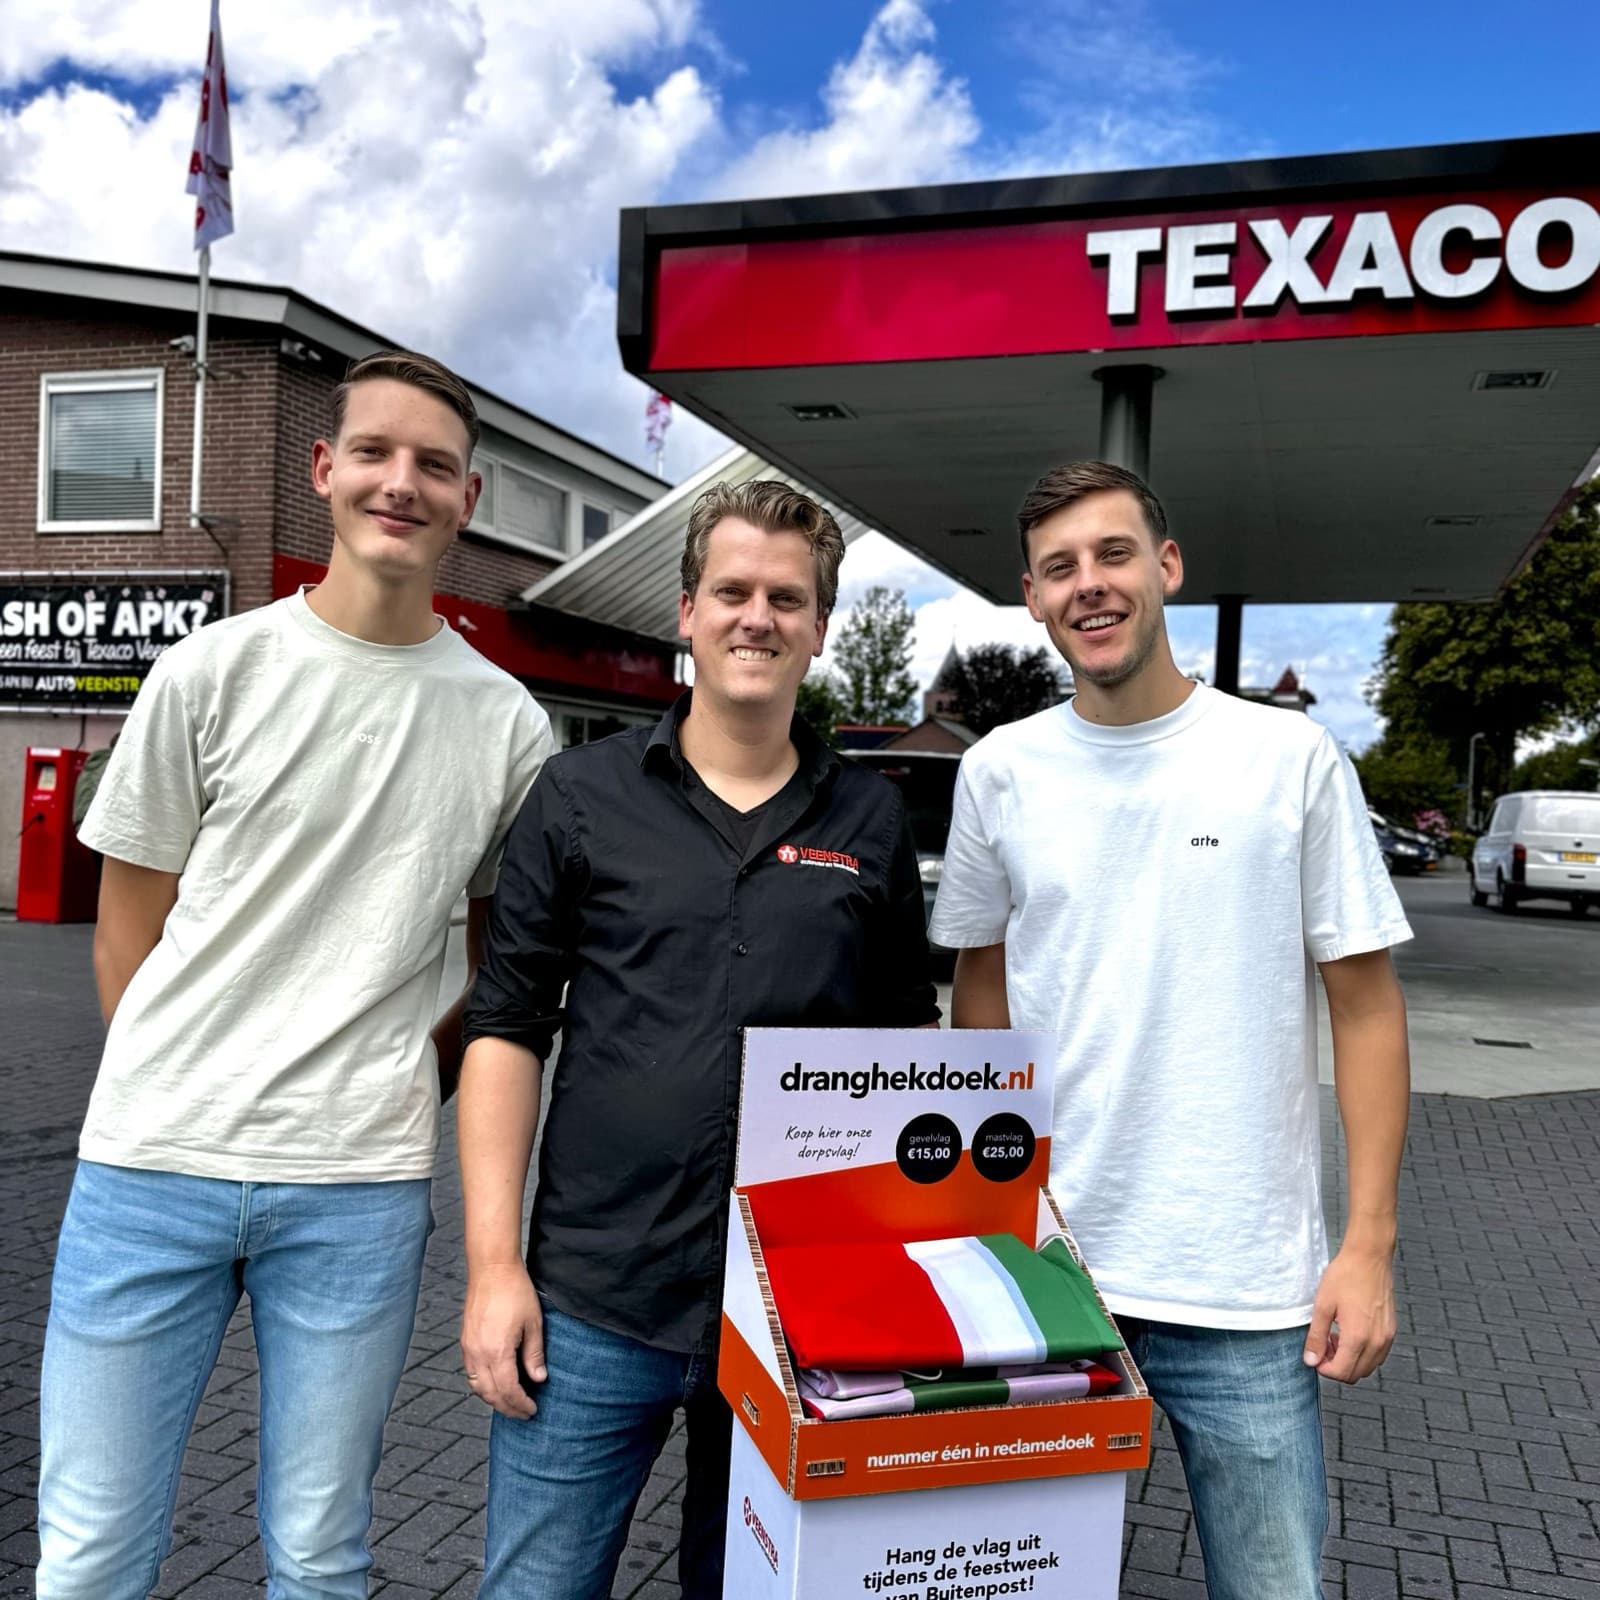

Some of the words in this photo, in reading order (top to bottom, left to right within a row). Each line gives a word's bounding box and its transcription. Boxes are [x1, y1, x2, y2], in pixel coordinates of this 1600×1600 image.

[1086, 197, 1600, 315] TEXACO
[0, 600, 51, 637] SH
[56, 600, 107, 637] OF
[111, 600, 208, 637] APK?
[24, 638, 62, 660] feest
[83, 637, 135, 661] Texaco
[35, 674, 143, 692] AUTOVEENSTR
[1190, 834, 1220, 848] arte
[799, 846, 860, 870] VEENSTRA
[780, 1062, 1035, 1099] dranghekdoek.nl
[785, 1125, 814, 1143] Koop
[818, 1125, 842, 1139] hier
[846, 1129, 873, 1138] onze
[909, 1132, 951, 1145] gevelvlag
[985, 1131, 1023, 1144] mastvlag
[797, 1142, 861, 1162] dorpsvlag!
[907, 1147, 951, 1160] €15,00
[982, 1146, 1025, 1160] €25,00
[867, 1450, 939, 1468] nummer
[941, 1444, 971, 1461] één
[975, 1442, 990, 1458] in
[993, 1432, 1096, 1456] reclamedoek
[886, 1547, 937, 1566] Hang
[942, 1541, 966, 1559] de
[972, 1537, 1011, 1557] vlag
[1017, 1533, 1041, 1551] uit
[863, 1569, 928, 1592] tijdens
[934, 1563, 958, 1581] de
[964, 1551, 1060, 1578] feestweek
[926, 1575, 1034, 1600] Buitenpost!
